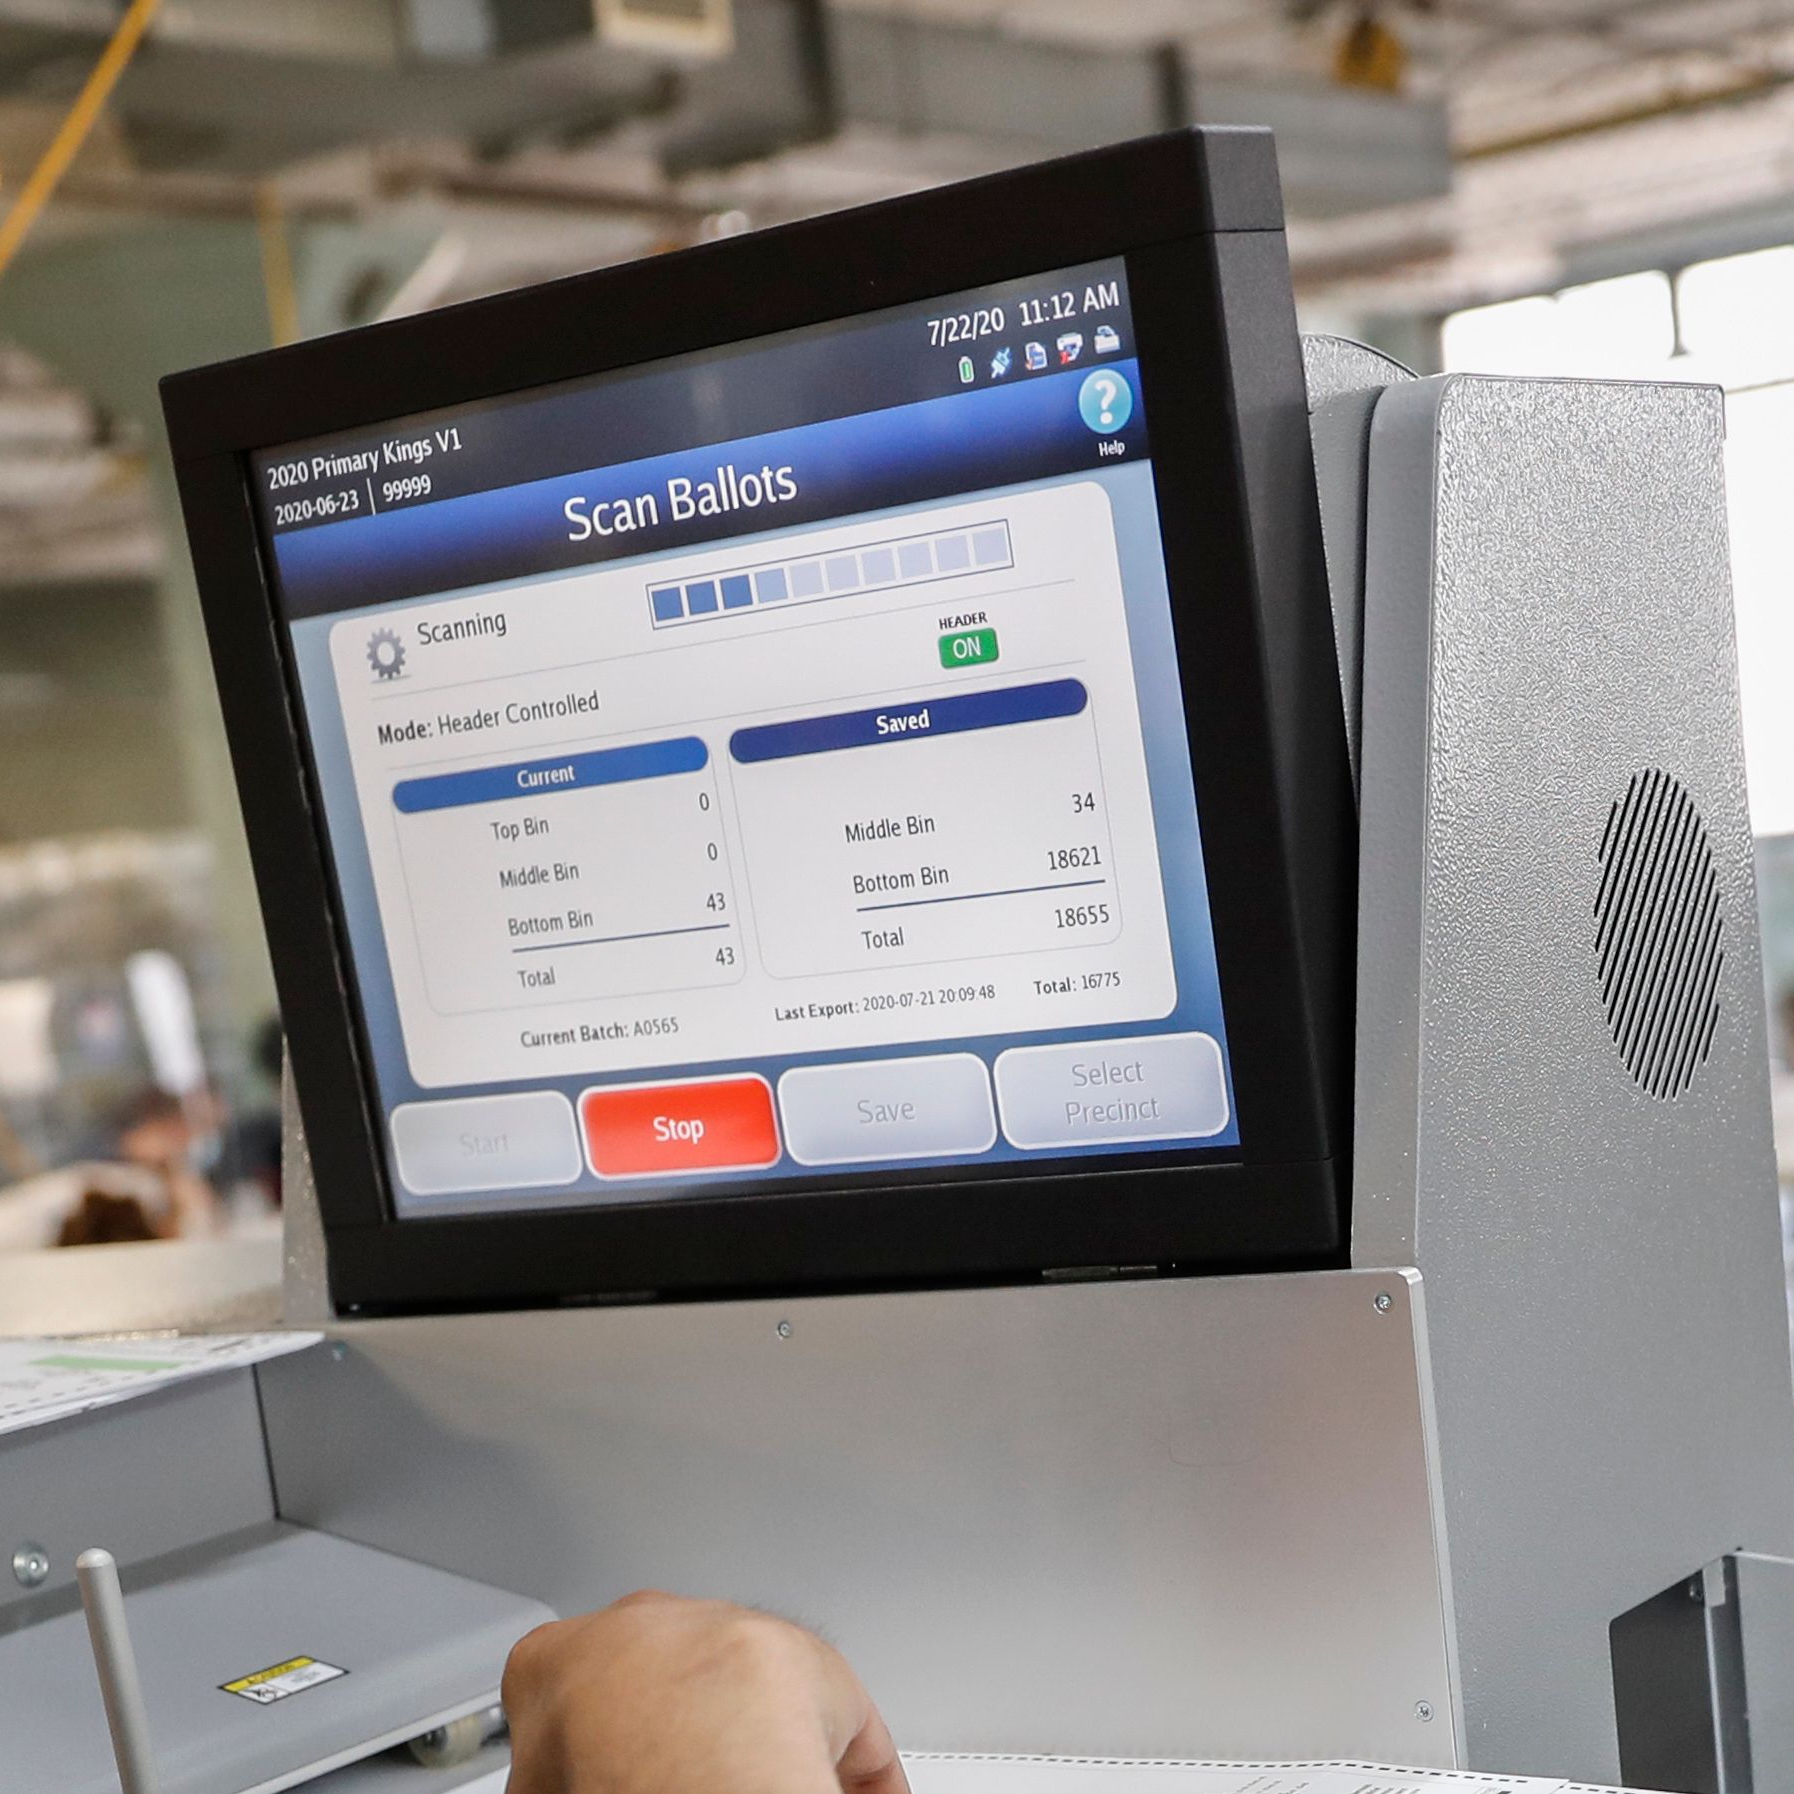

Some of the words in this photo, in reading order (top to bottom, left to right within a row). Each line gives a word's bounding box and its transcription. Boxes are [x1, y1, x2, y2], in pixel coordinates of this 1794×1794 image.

[927, 307, 1004, 347] 7/22/20
[1019, 291, 1076, 326] 11:12
[1083, 282, 1118, 313] AM
[268, 459, 307, 490] 2020
[312, 449, 378, 484] Primary
[383, 437, 432, 467] Kings
[436, 428, 461, 452] V1
[1099, 439, 1125, 459] Help
[275, 490, 360, 525] 2020-06-23
[383, 473, 431, 502] 99999
[563, 493, 658, 541] Scan
[667, 464, 797, 521] Ballots
[417, 610, 507, 647] Scanning
[939, 611, 987, 631] HEADER
[953, 636, 981, 660] ON
[377, 723, 433, 745] Mode:
[437, 709, 500, 735] Header
[506, 690, 599, 724] Controlled
[876, 709, 929, 734] Saved
[517, 765, 575, 788] Current
[490, 822, 520, 841] Top
[523, 816, 549, 836] Bin
[699, 793, 709, 810] 0
[844, 817, 902, 843] Middle
[907, 814, 935, 834] Bin
[1072, 792, 1095, 813] 34
[499, 866, 549, 888] Middle
[553, 862, 579, 881] Bin
[707, 842, 717, 860] 0
[853, 873, 915, 894] Bottom
[920, 865, 950, 886] Bin
[1047, 846, 1101, 871] 18621
[508, 914, 564, 937] Bottom
[567, 909, 593, 929] Bin
[706, 893, 726, 911] 43
[862, 926, 904, 950] Total
[1055, 904, 1109, 928] 18655
[518, 966, 556, 988] Total
[715, 947, 735, 965] 43
[775, 1005, 805, 1021] Last
[808, 998, 859, 1019] Export:
[863, 992, 935, 1011] 2020-07-21
[1033, 978, 1076, 996] Total:
[1081, 971, 1121, 991] 16775
[521, 1028, 575, 1048] Current
[580, 1022, 629, 1042] Batch:
[1072, 1060, 1144, 1087] Select
[653, 1113, 704, 1143] Stop
[857, 1096, 916, 1125] Save
[1066, 1096, 1159, 1126] Precinct
